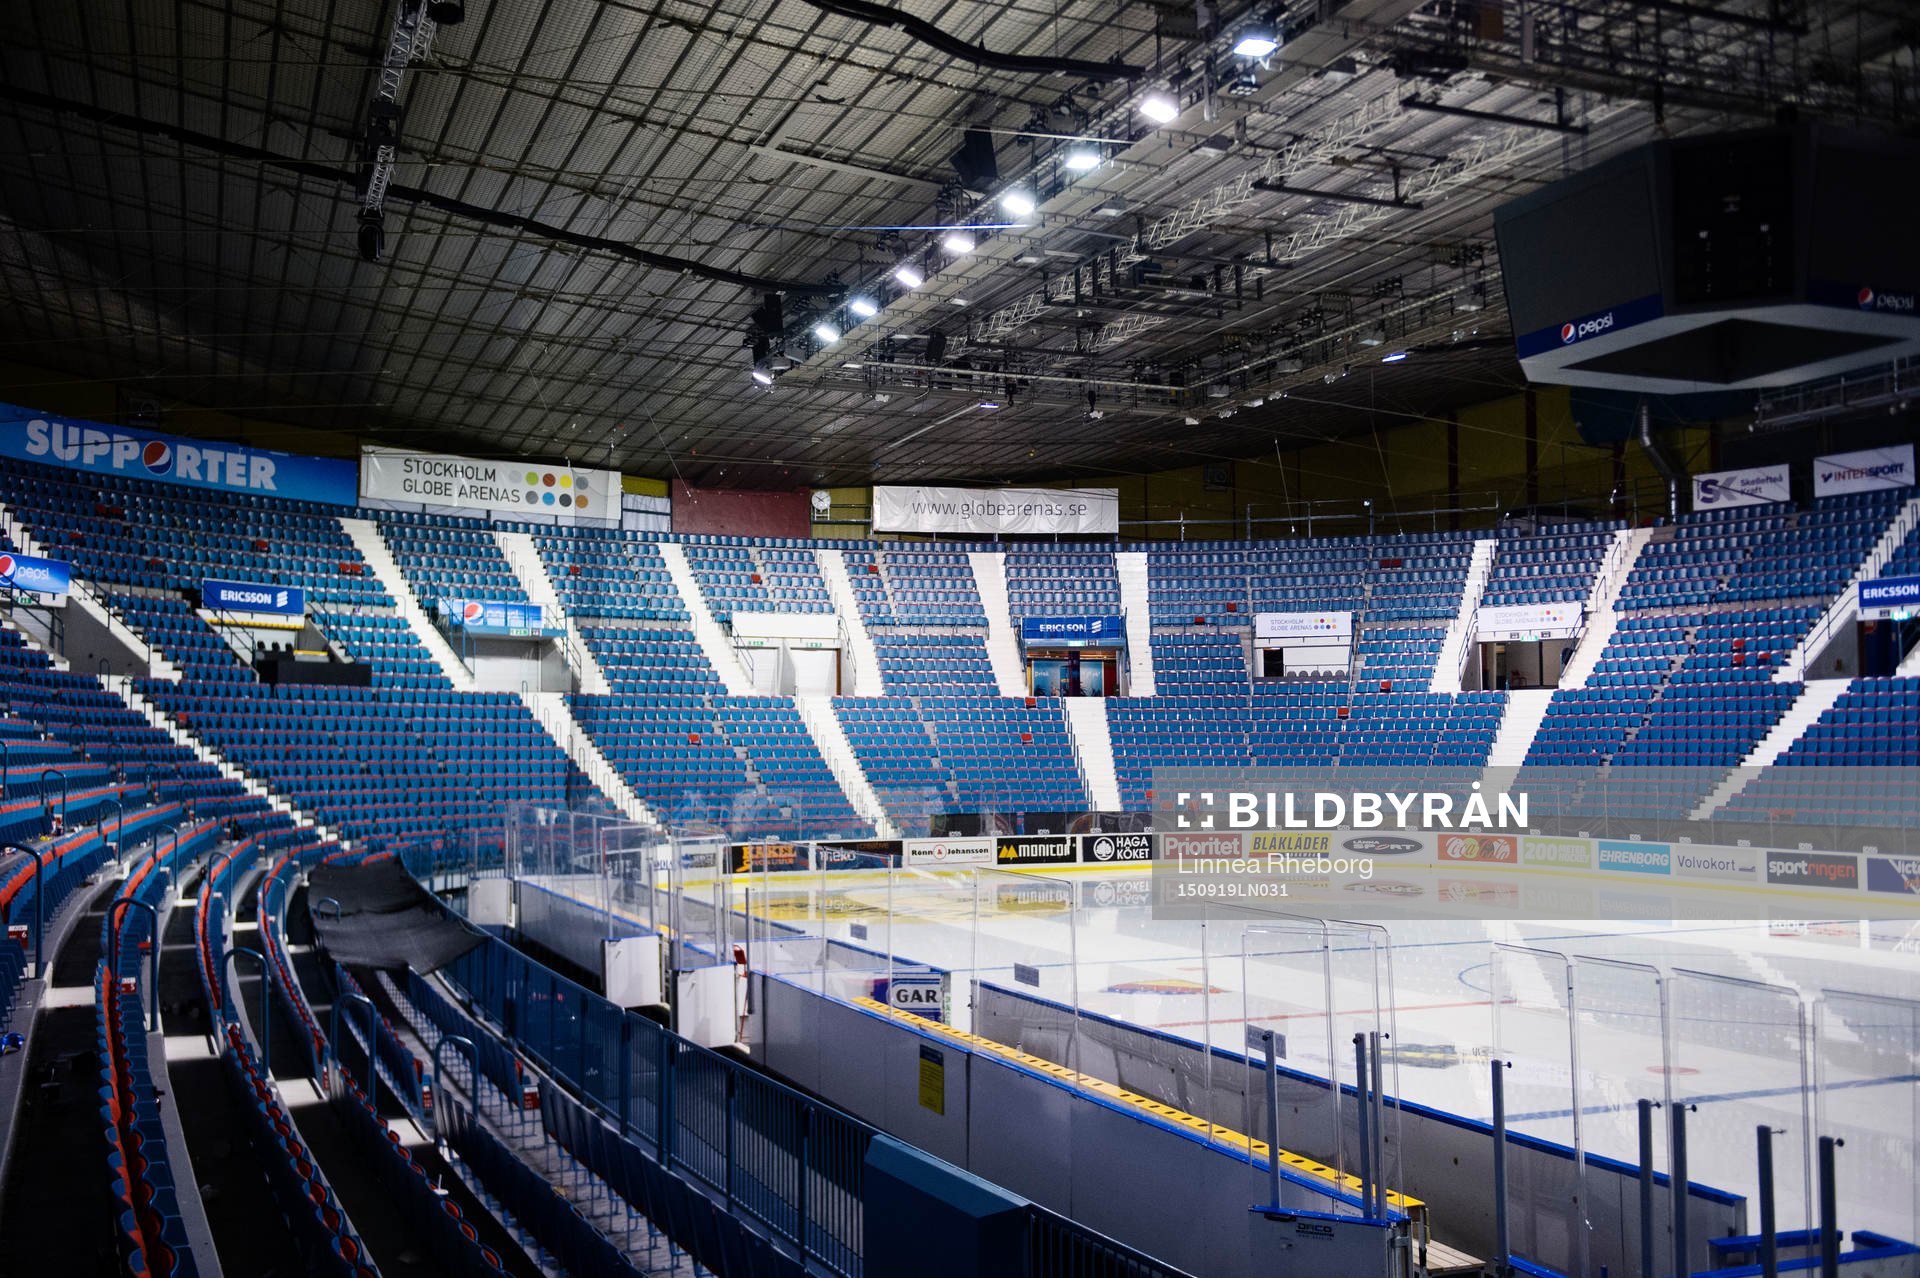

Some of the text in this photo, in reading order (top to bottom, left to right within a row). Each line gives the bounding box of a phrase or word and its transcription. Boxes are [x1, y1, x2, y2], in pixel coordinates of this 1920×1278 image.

[1876, 293, 1914, 311] pepsi
[1578, 311, 1614, 338] pepsi
[403, 458, 496, 482] STOCKHOLM
[1834, 463, 1904, 482] INTERSPORT
[403, 478, 521, 503] GLOBE ARENAS
[912, 500, 1087, 519] www.globearenas.se
[17, 566, 49, 582] pepsi
[220, 589, 272, 604] ERICSSON
[1862, 584, 1919, 599] ERICSSON
[1116, 836, 1149, 847] HAGA
[1165, 837, 1241, 857] Prioritet
[947, 847, 989, 855] Johansson
[1116, 847, 1150, 860] KÖKET
[1525, 842, 1557, 861] 200
[1600, 850, 1669, 866] EHRENBORG
[1678, 855, 1735, 871] Volvokort
[1769, 860, 1855, 880] sportringen
[896, 989, 938, 1003] GAR
